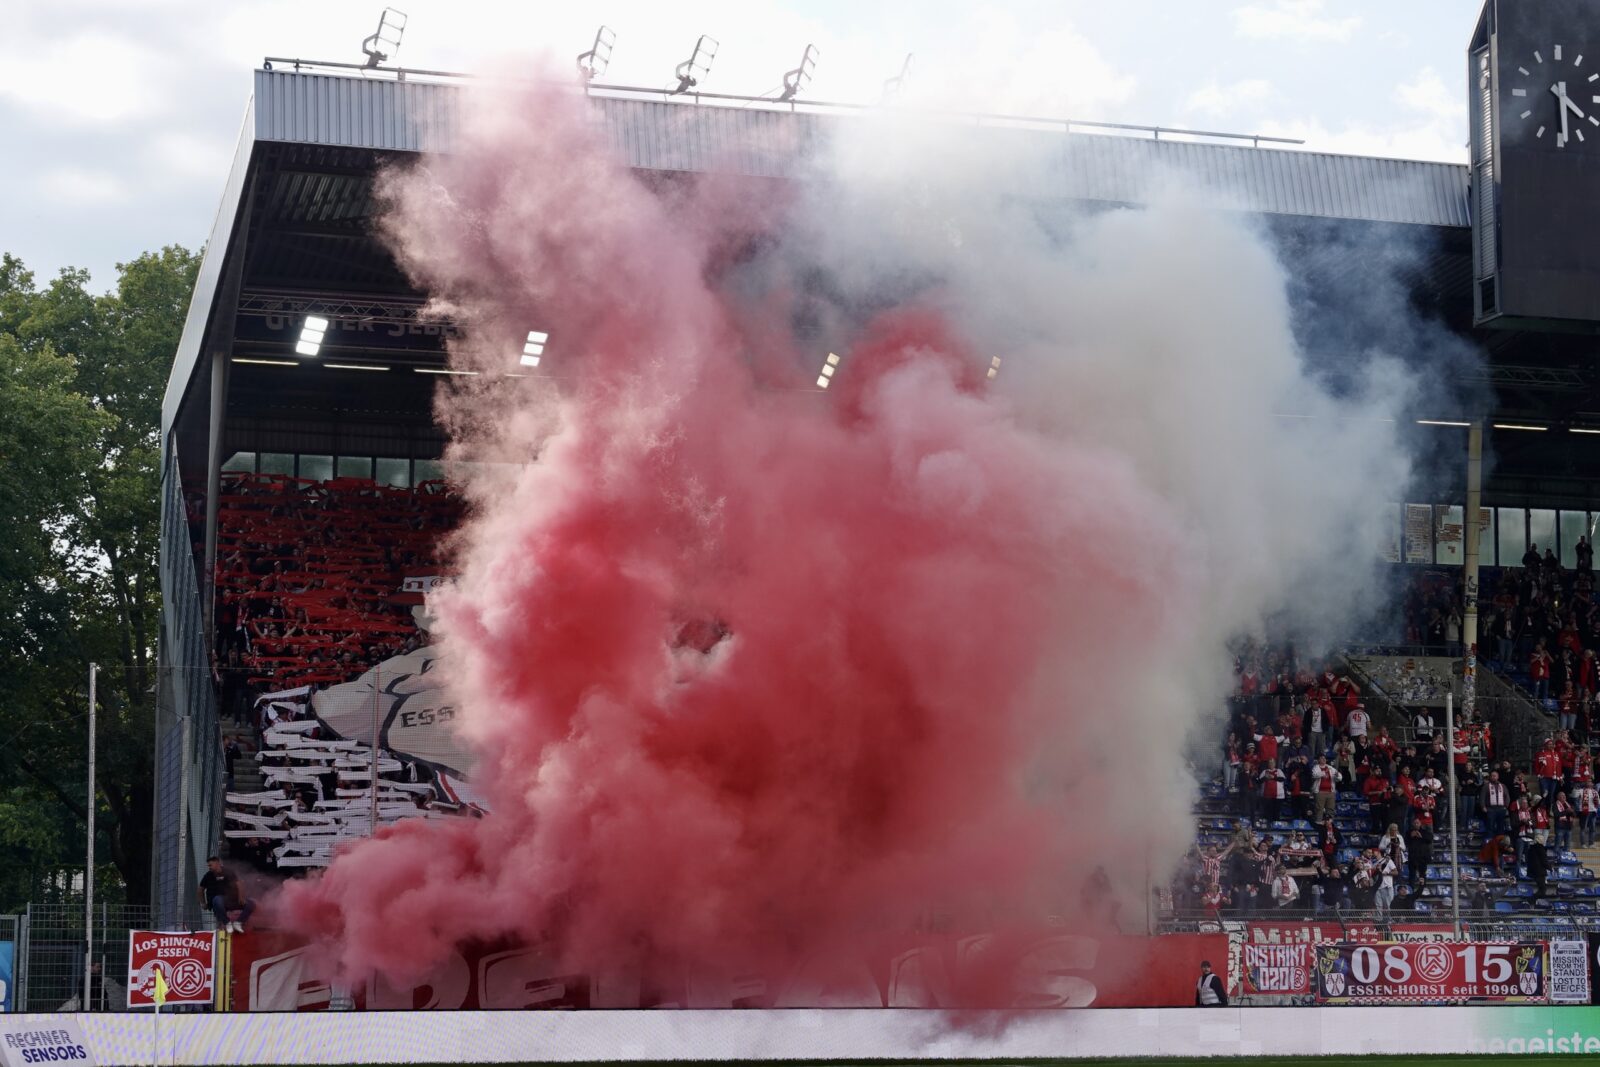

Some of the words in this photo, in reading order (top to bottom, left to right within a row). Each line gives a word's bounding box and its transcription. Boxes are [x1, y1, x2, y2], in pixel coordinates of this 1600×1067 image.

[135, 938, 158, 954] LOS
[160, 936, 212, 952] HINCHAS
[157, 947, 190, 958] ESSEN
[1351, 945, 1412, 984] 08
[1456, 945, 1513, 983] 15
[1347, 984, 1447, 996] ESSEN-HORST
[1452, 984, 1478, 995] seit
[1484, 984, 1518, 995] 1996
[1553, 977, 1574, 985] LOST
[1575, 977, 1586, 985] TO
[4, 1030, 73, 1049] RECHNER
[22, 1045, 87, 1063] SENSORS
